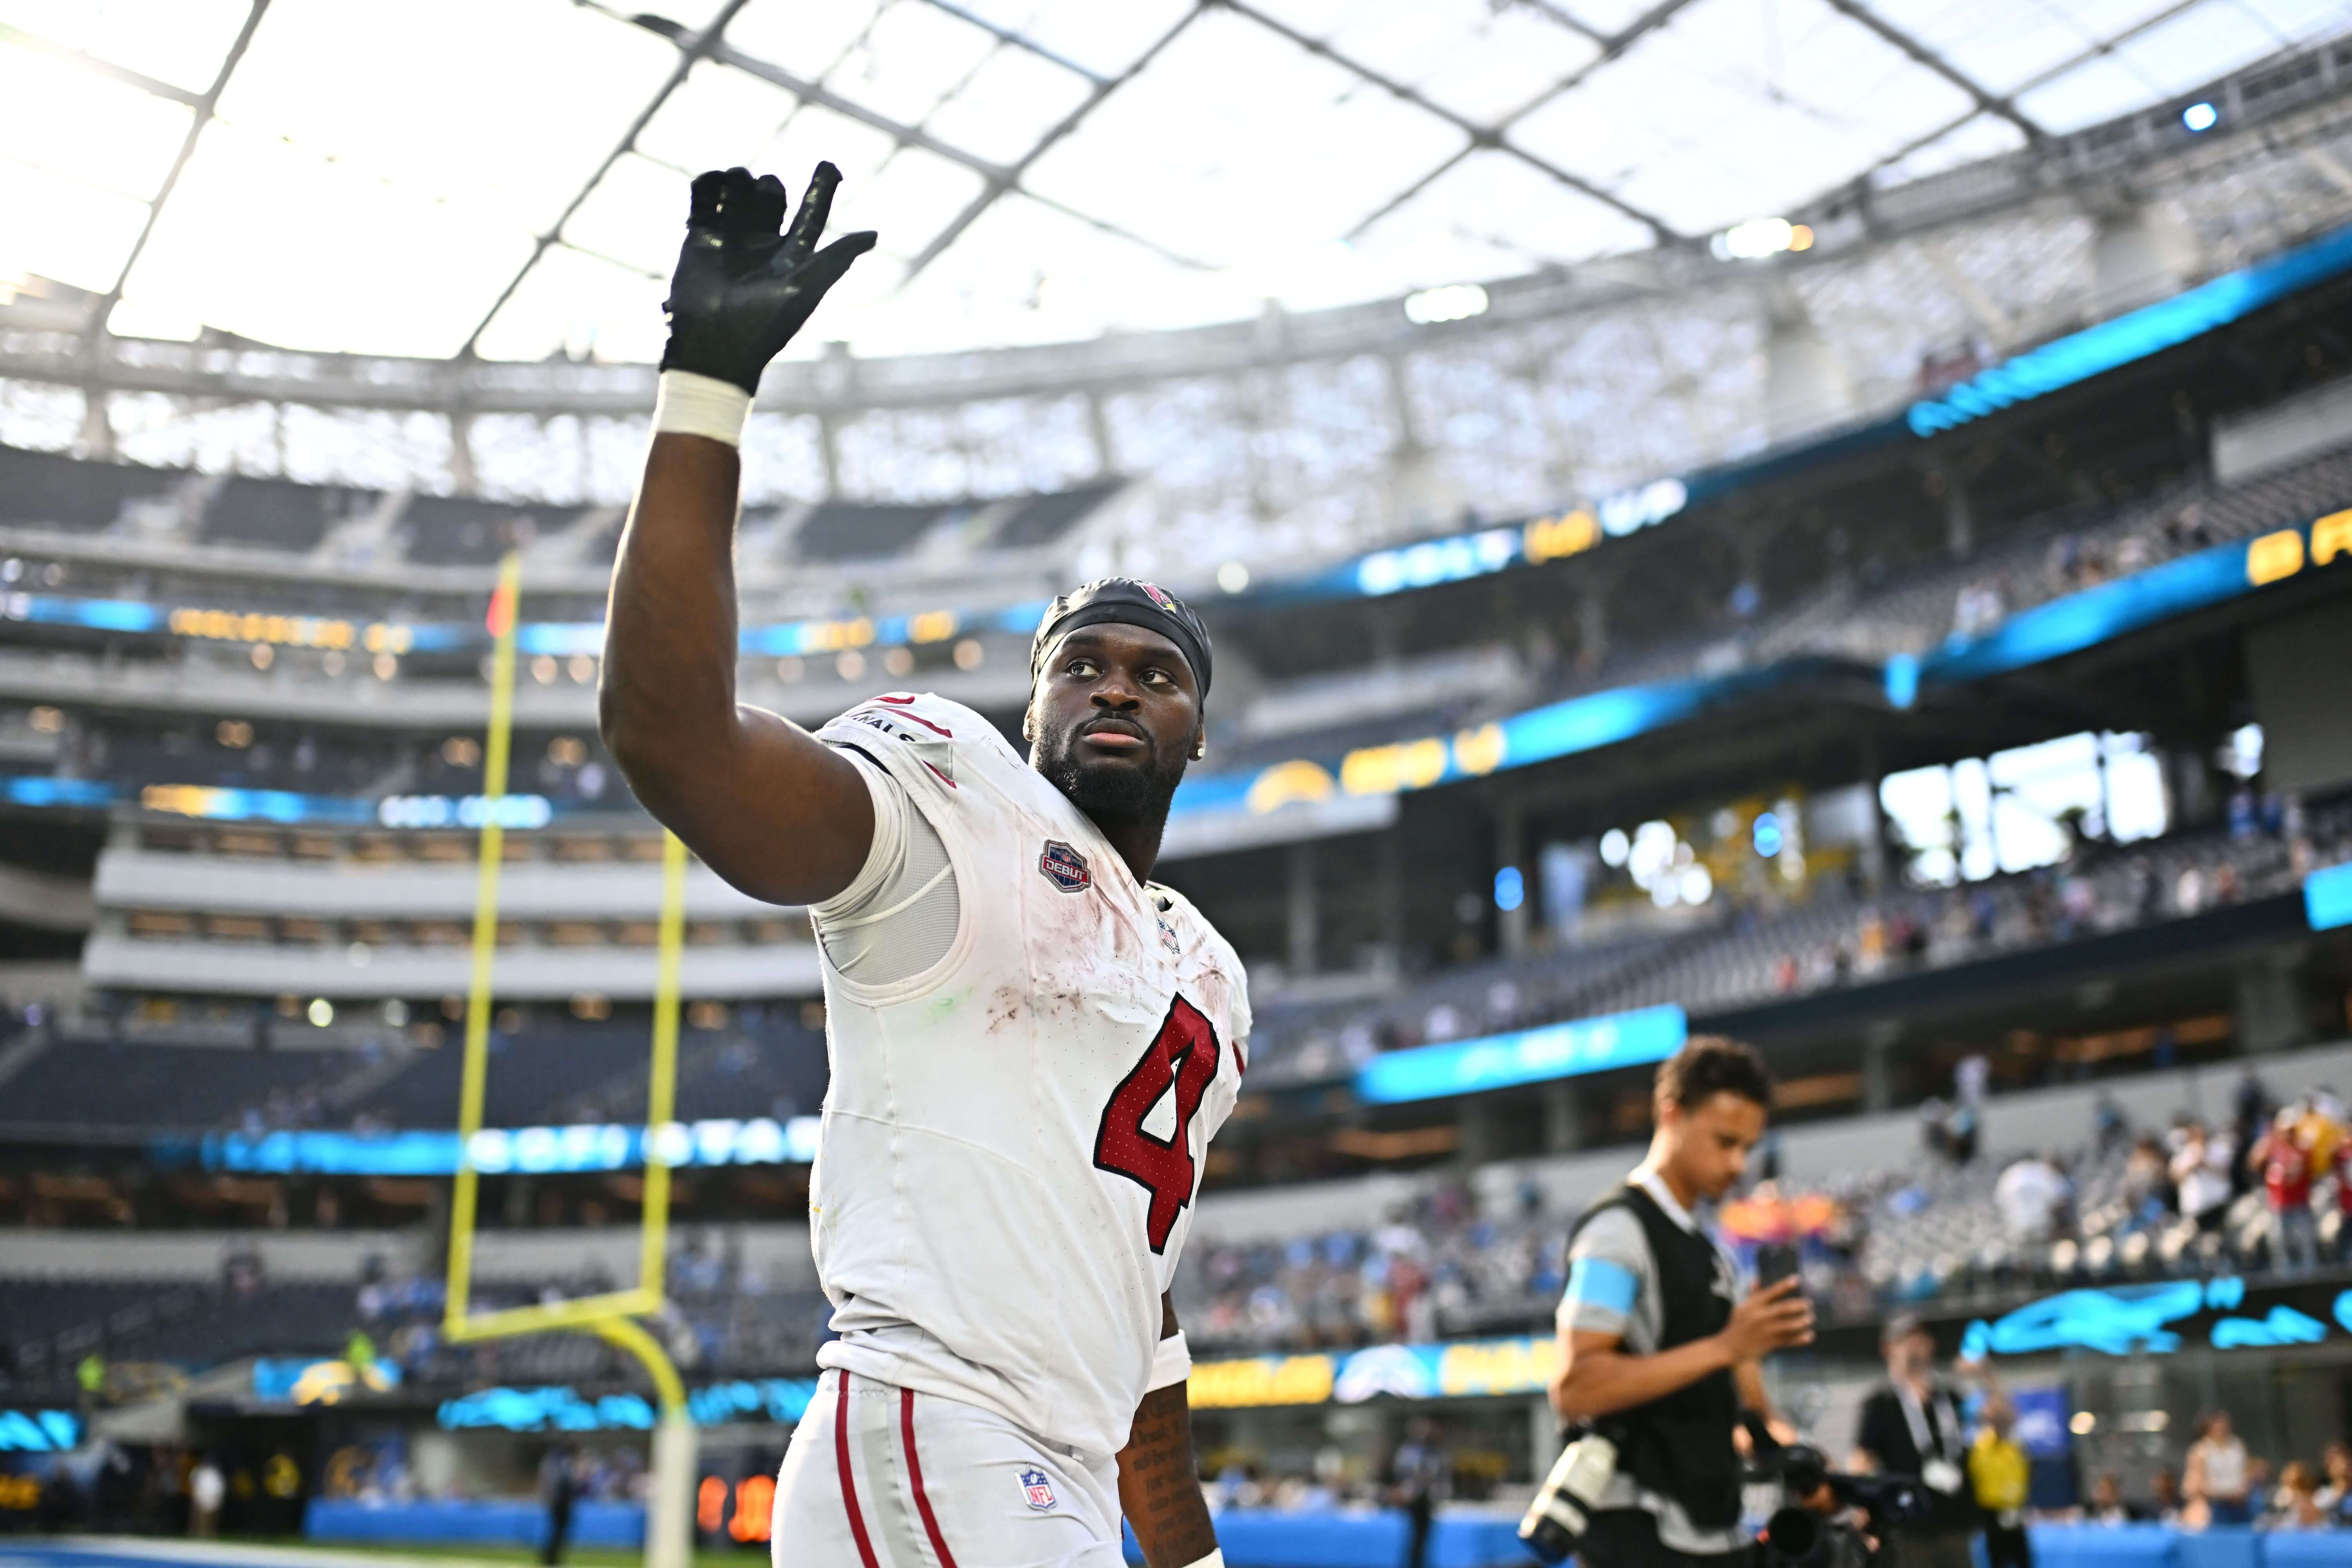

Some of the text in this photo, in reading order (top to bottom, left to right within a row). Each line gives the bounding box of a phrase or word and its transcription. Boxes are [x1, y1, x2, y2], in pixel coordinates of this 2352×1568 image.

[1062, 854, 1071, 862] NFL
[1046, 859, 1085, 880] DEBUT
[1093, 991, 1220, 1256] 4
[1028, 1486, 1054, 1504] NFL
